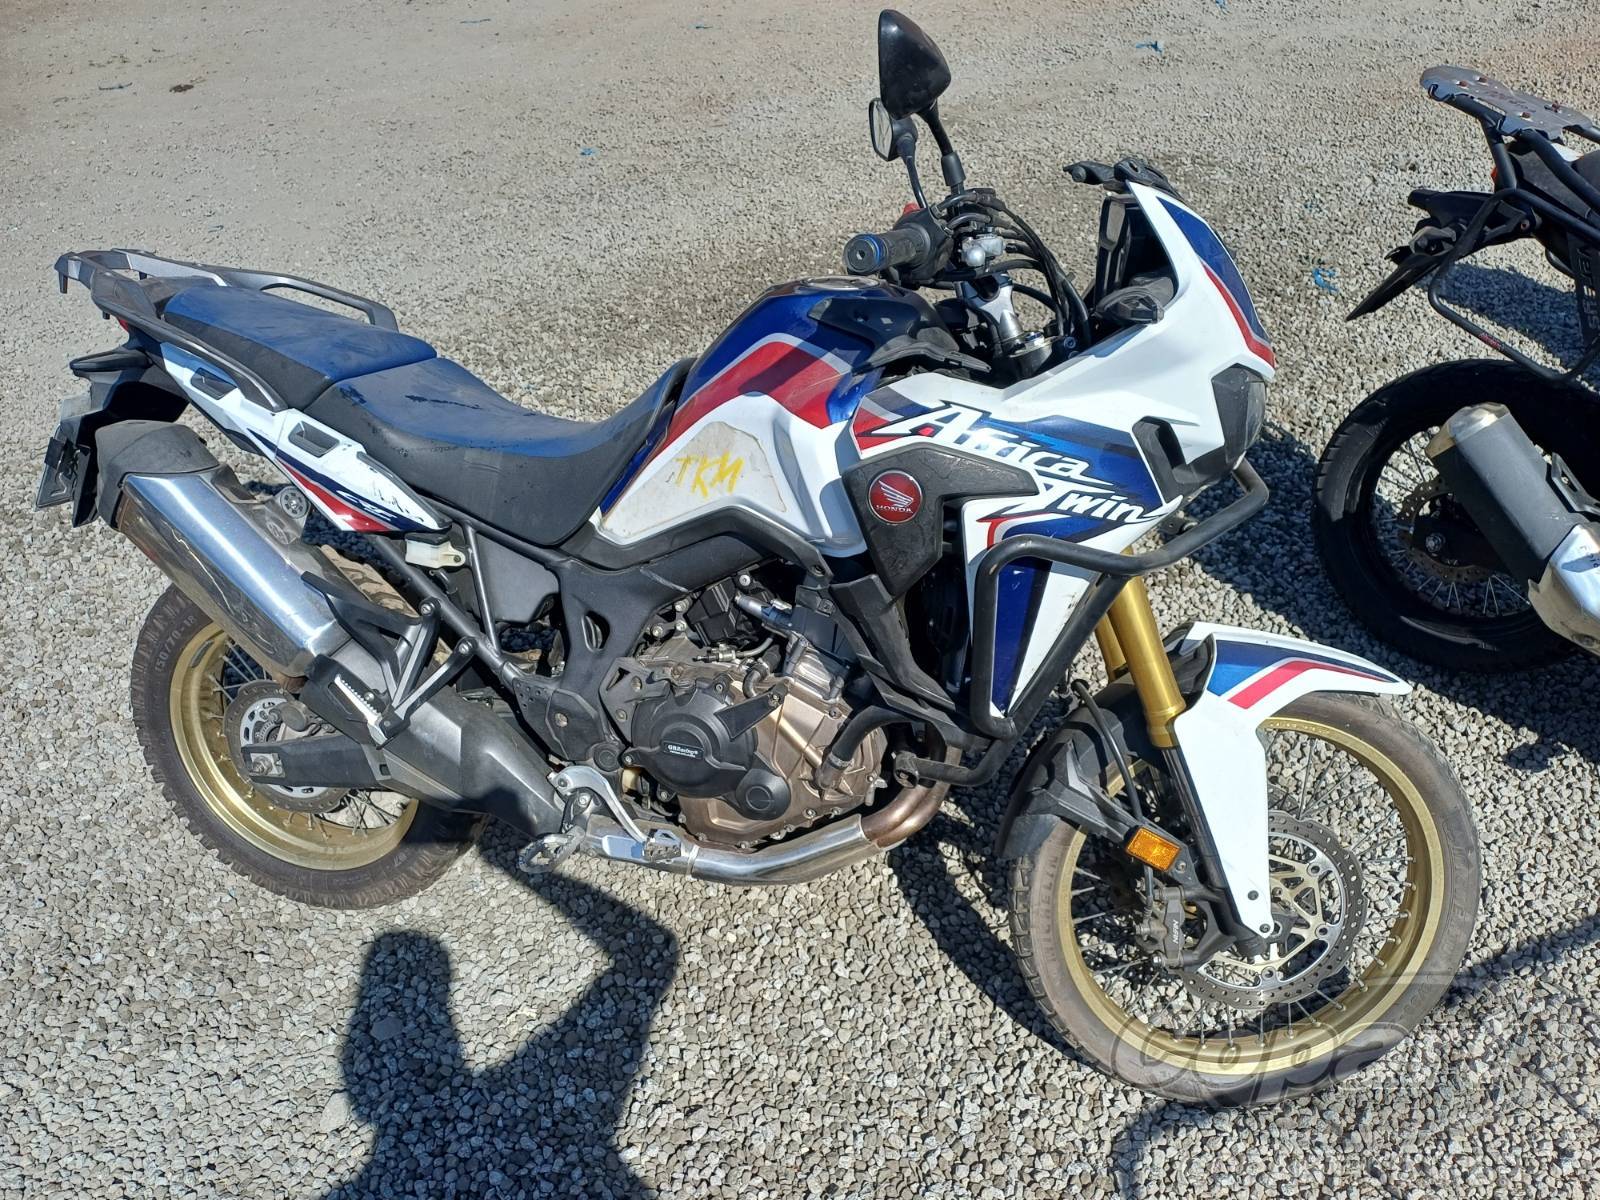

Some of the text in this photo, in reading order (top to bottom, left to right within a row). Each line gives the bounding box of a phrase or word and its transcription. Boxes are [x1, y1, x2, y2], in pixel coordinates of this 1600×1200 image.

[857, 400, 1114, 487] Africa
[874, 503, 913, 514] HONDA
[1000, 472, 1183, 524] Twin
